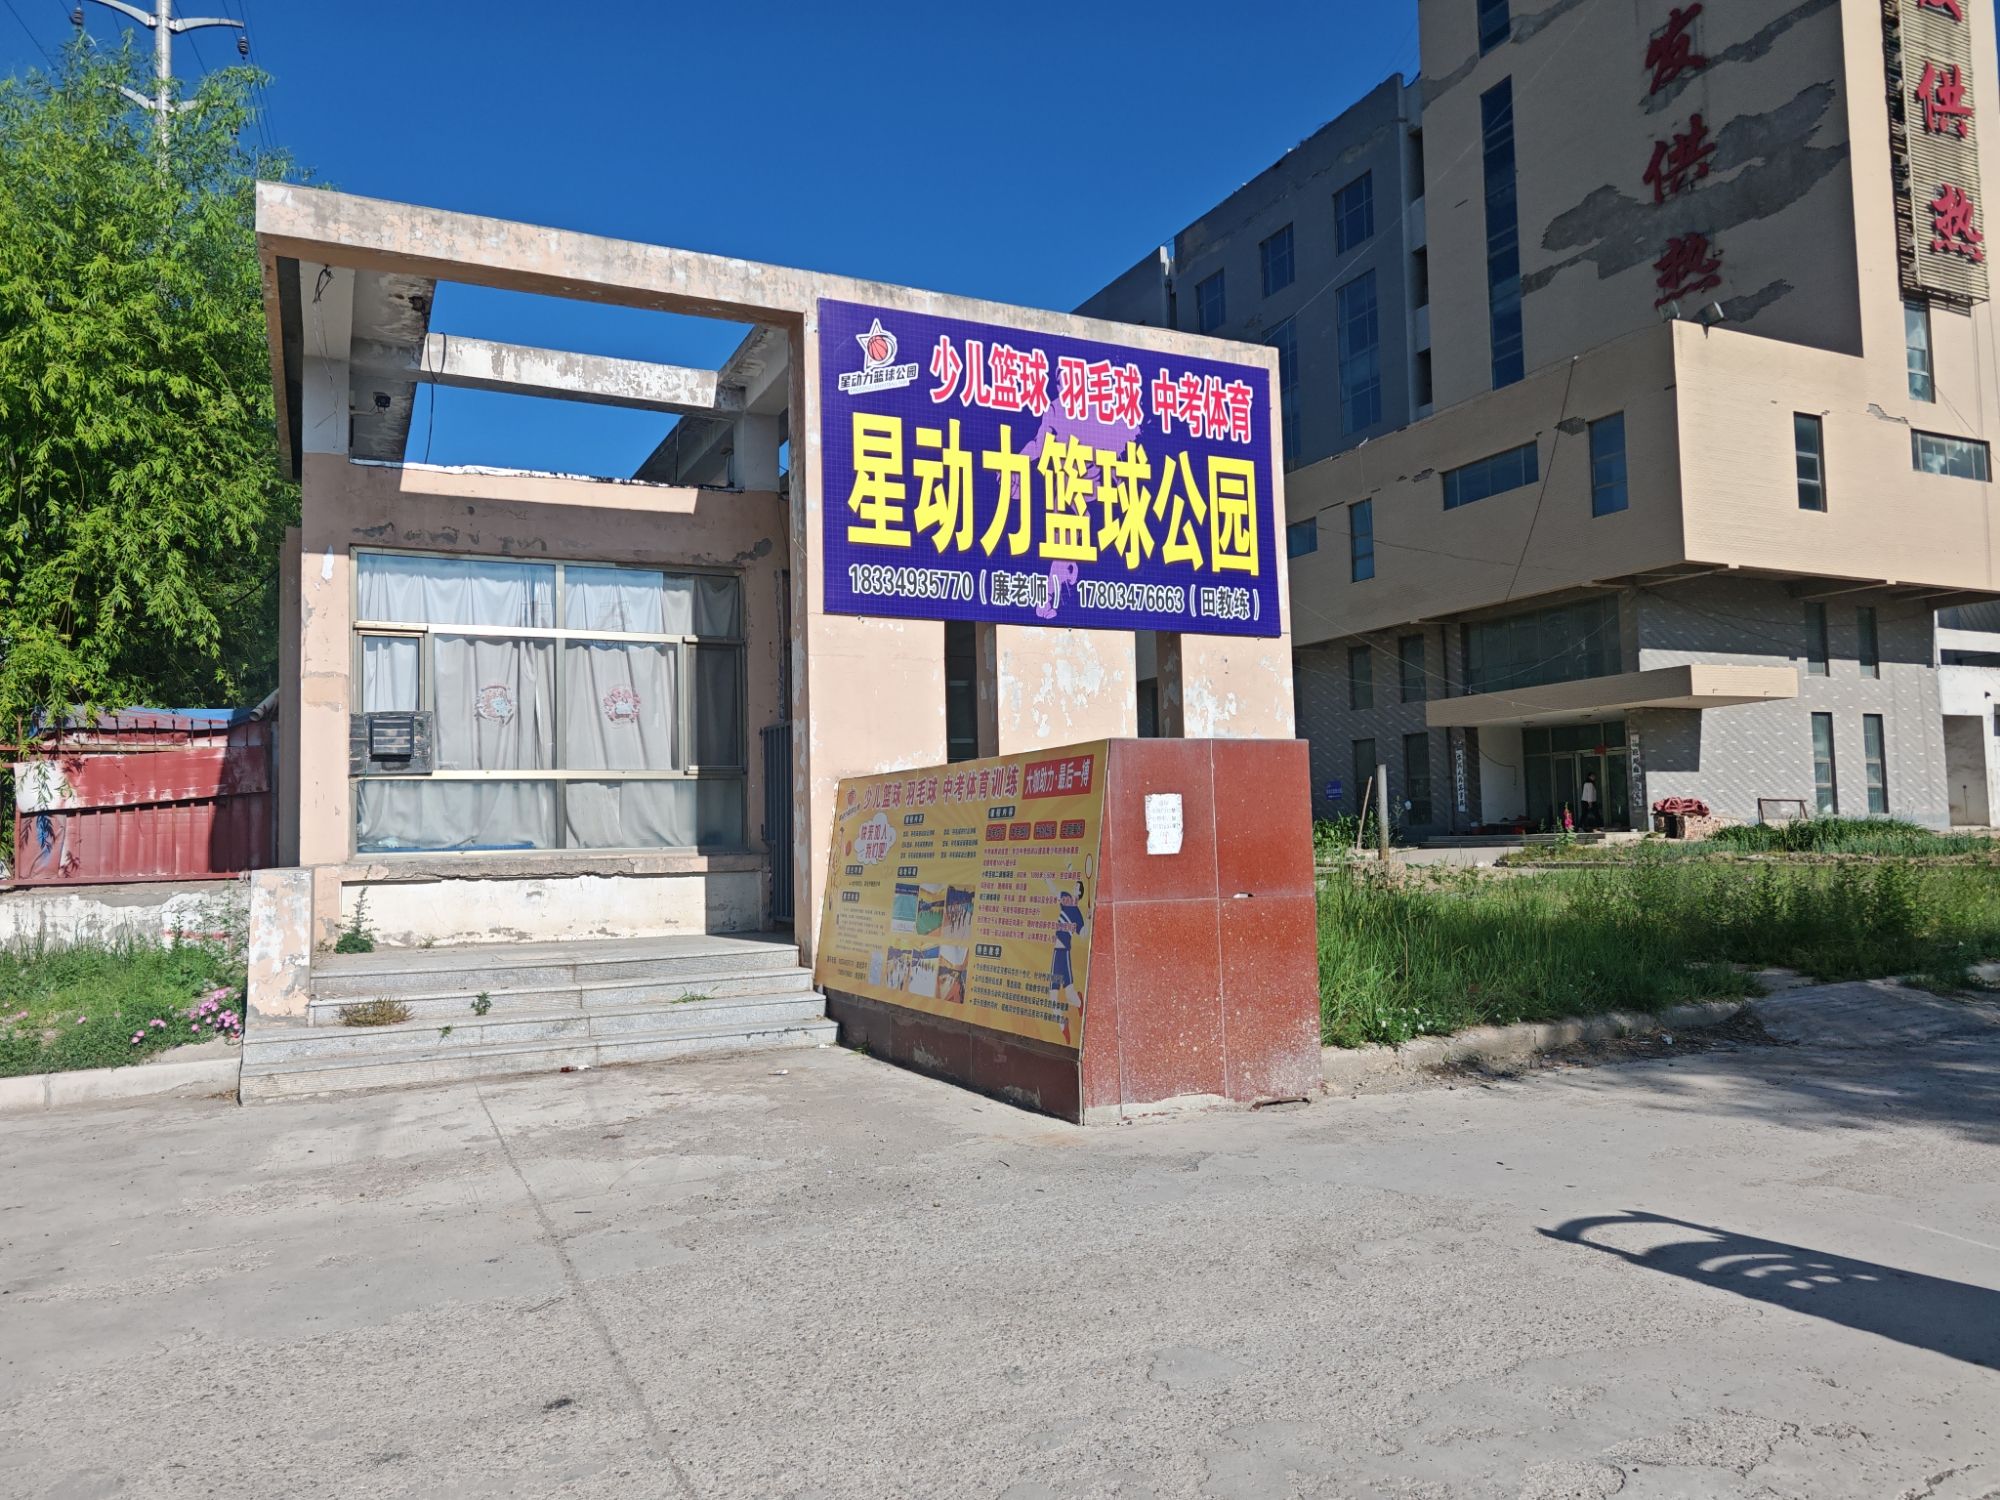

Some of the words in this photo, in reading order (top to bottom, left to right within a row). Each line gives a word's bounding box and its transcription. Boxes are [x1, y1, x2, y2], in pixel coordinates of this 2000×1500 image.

[1916, 0, 1985, 263] 供热
[841, 365, 917, 389] 星动力篮球公园
[930, 335, 1050, 416] 少儿篮球
[1058, 356, 1143, 428] 羽毛球
[1151, 368, 1253, 443] 中考体育
[847, 412, 1260, 576] 星动力篮球公园
[863, 782, 902, 811] 少儿篮球
[906, 776, 938, 807] 羽毛球
[942, 763, 1020, 805] 中考体育训练
